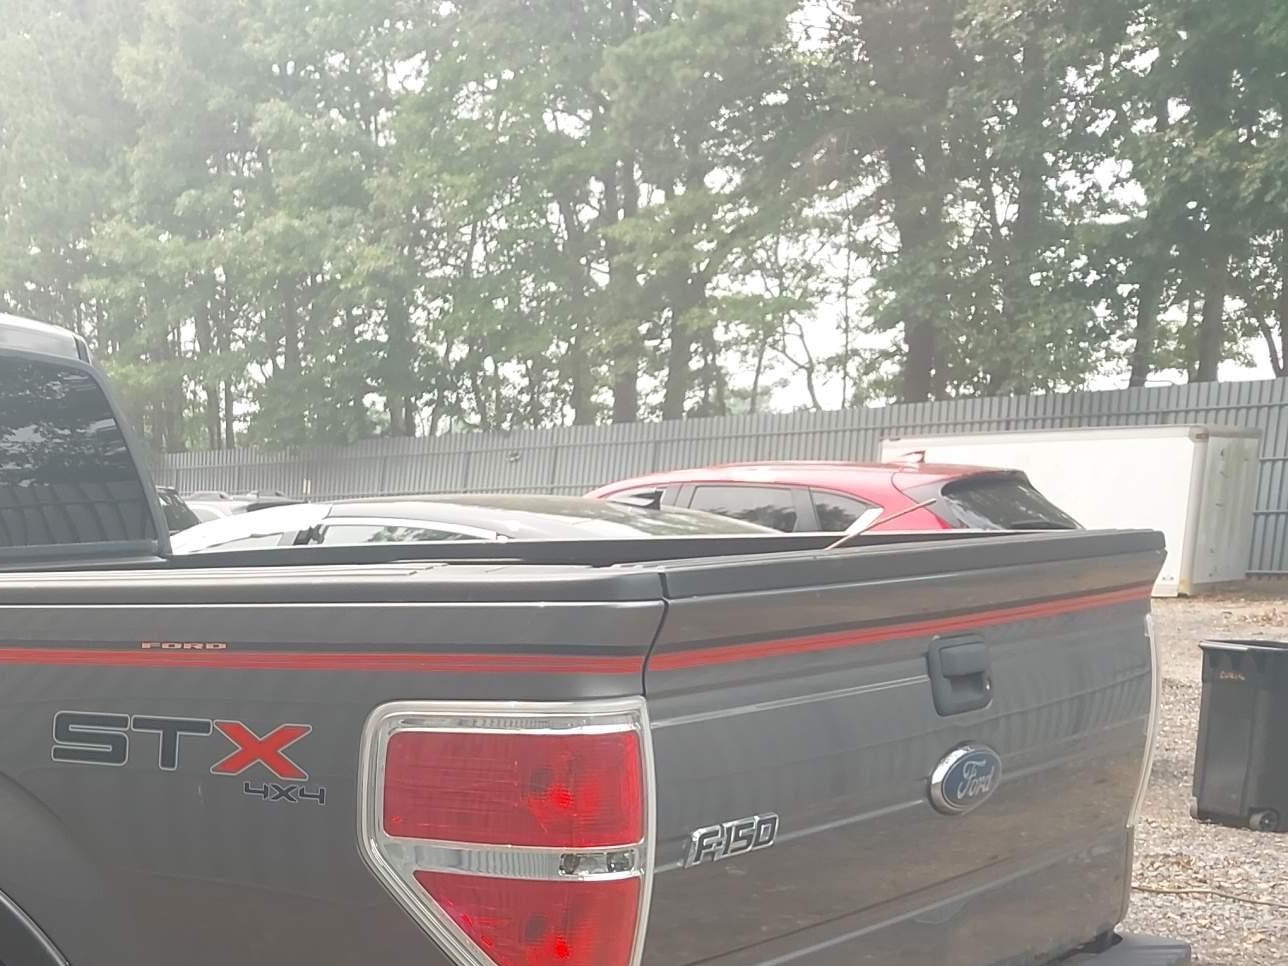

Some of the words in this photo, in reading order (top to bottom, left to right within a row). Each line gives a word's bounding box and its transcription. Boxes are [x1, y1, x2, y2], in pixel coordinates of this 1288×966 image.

[140, 641, 228, 650] FORD
[51, 710, 313, 781] STX
[957, 759, 995, 800] Ford
